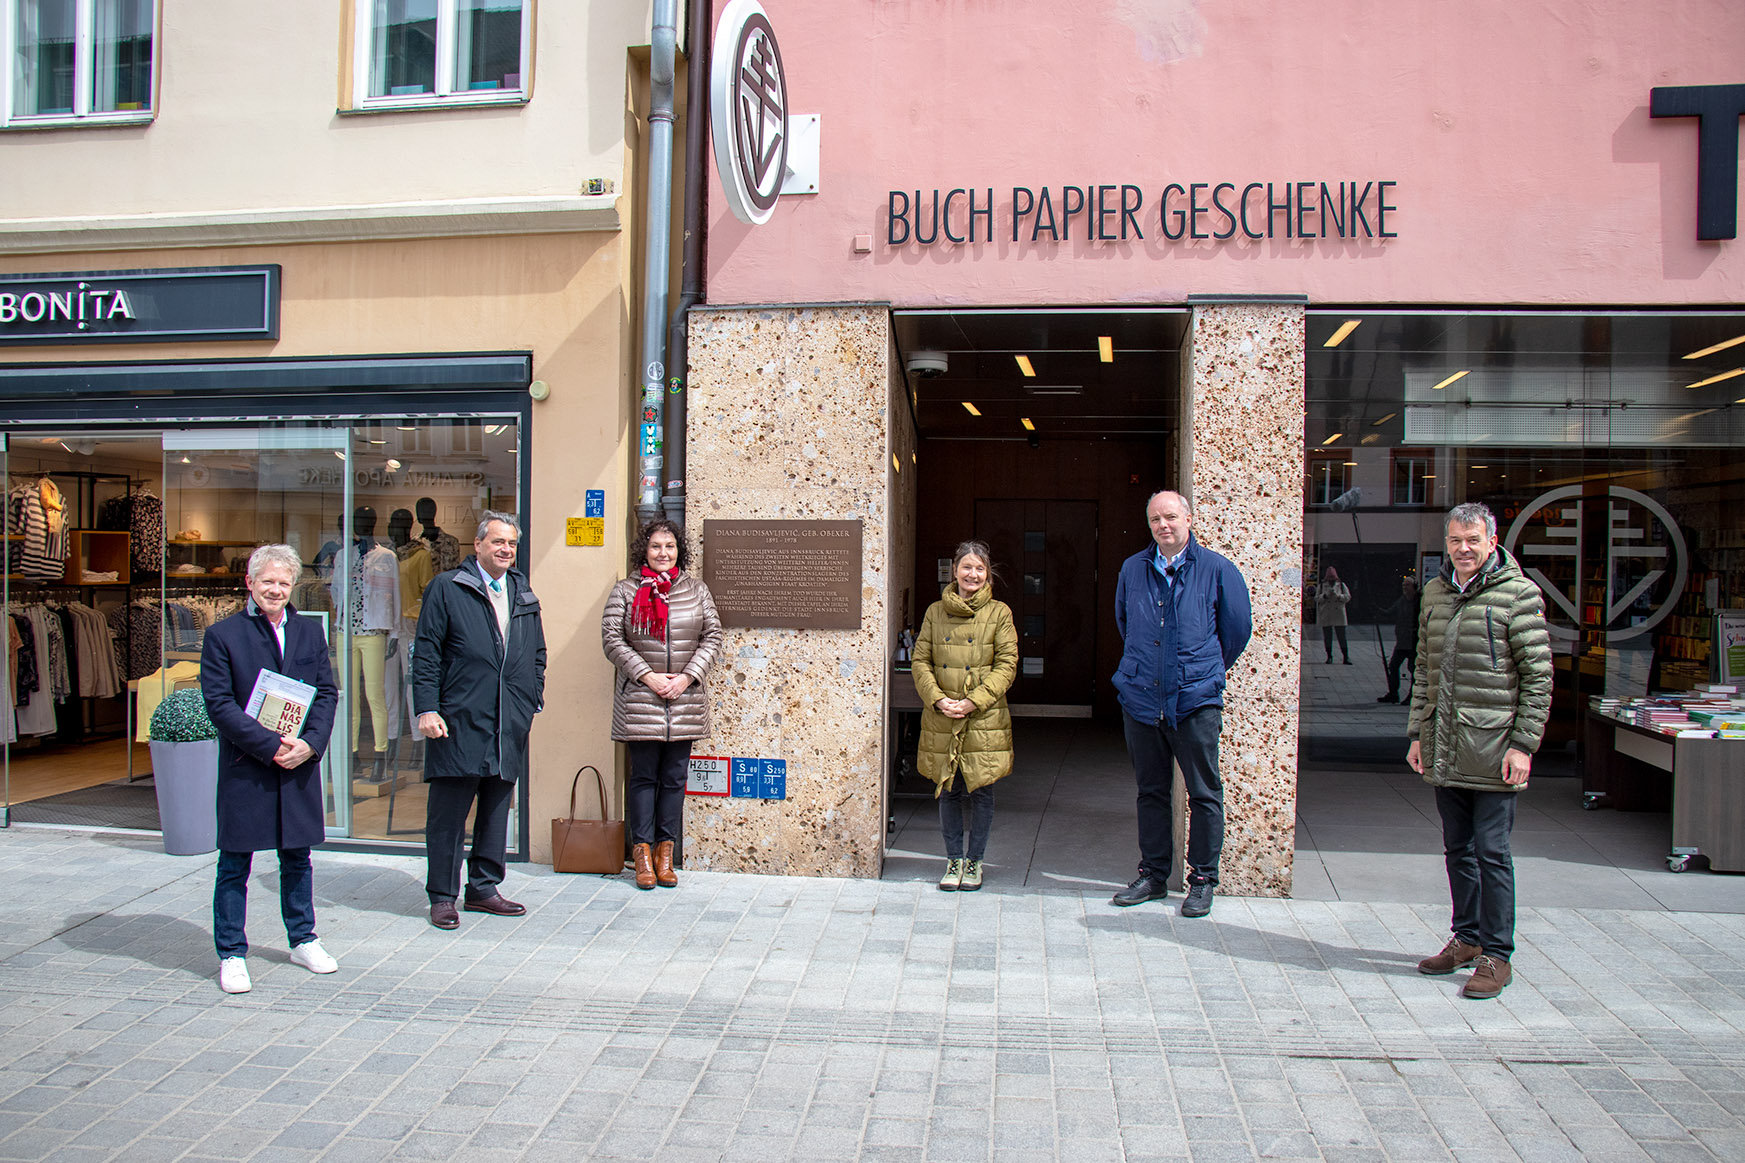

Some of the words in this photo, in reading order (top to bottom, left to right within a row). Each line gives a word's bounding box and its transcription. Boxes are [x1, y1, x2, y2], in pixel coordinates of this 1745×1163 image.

[1650, 84, 1745, 241] T
[888, 187, 993, 245] BUCH
[1012, 184, 1144, 242] PAPIER
[1160, 181, 1398, 240] GESCHENKE
[0, 281, 132, 330] BONITA
[716, 529, 740, 537] DIANA
[801, 529, 819, 537] GEB.
[820, 529, 850, 537] OBEXER
[280, 711, 301, 725] NAS
